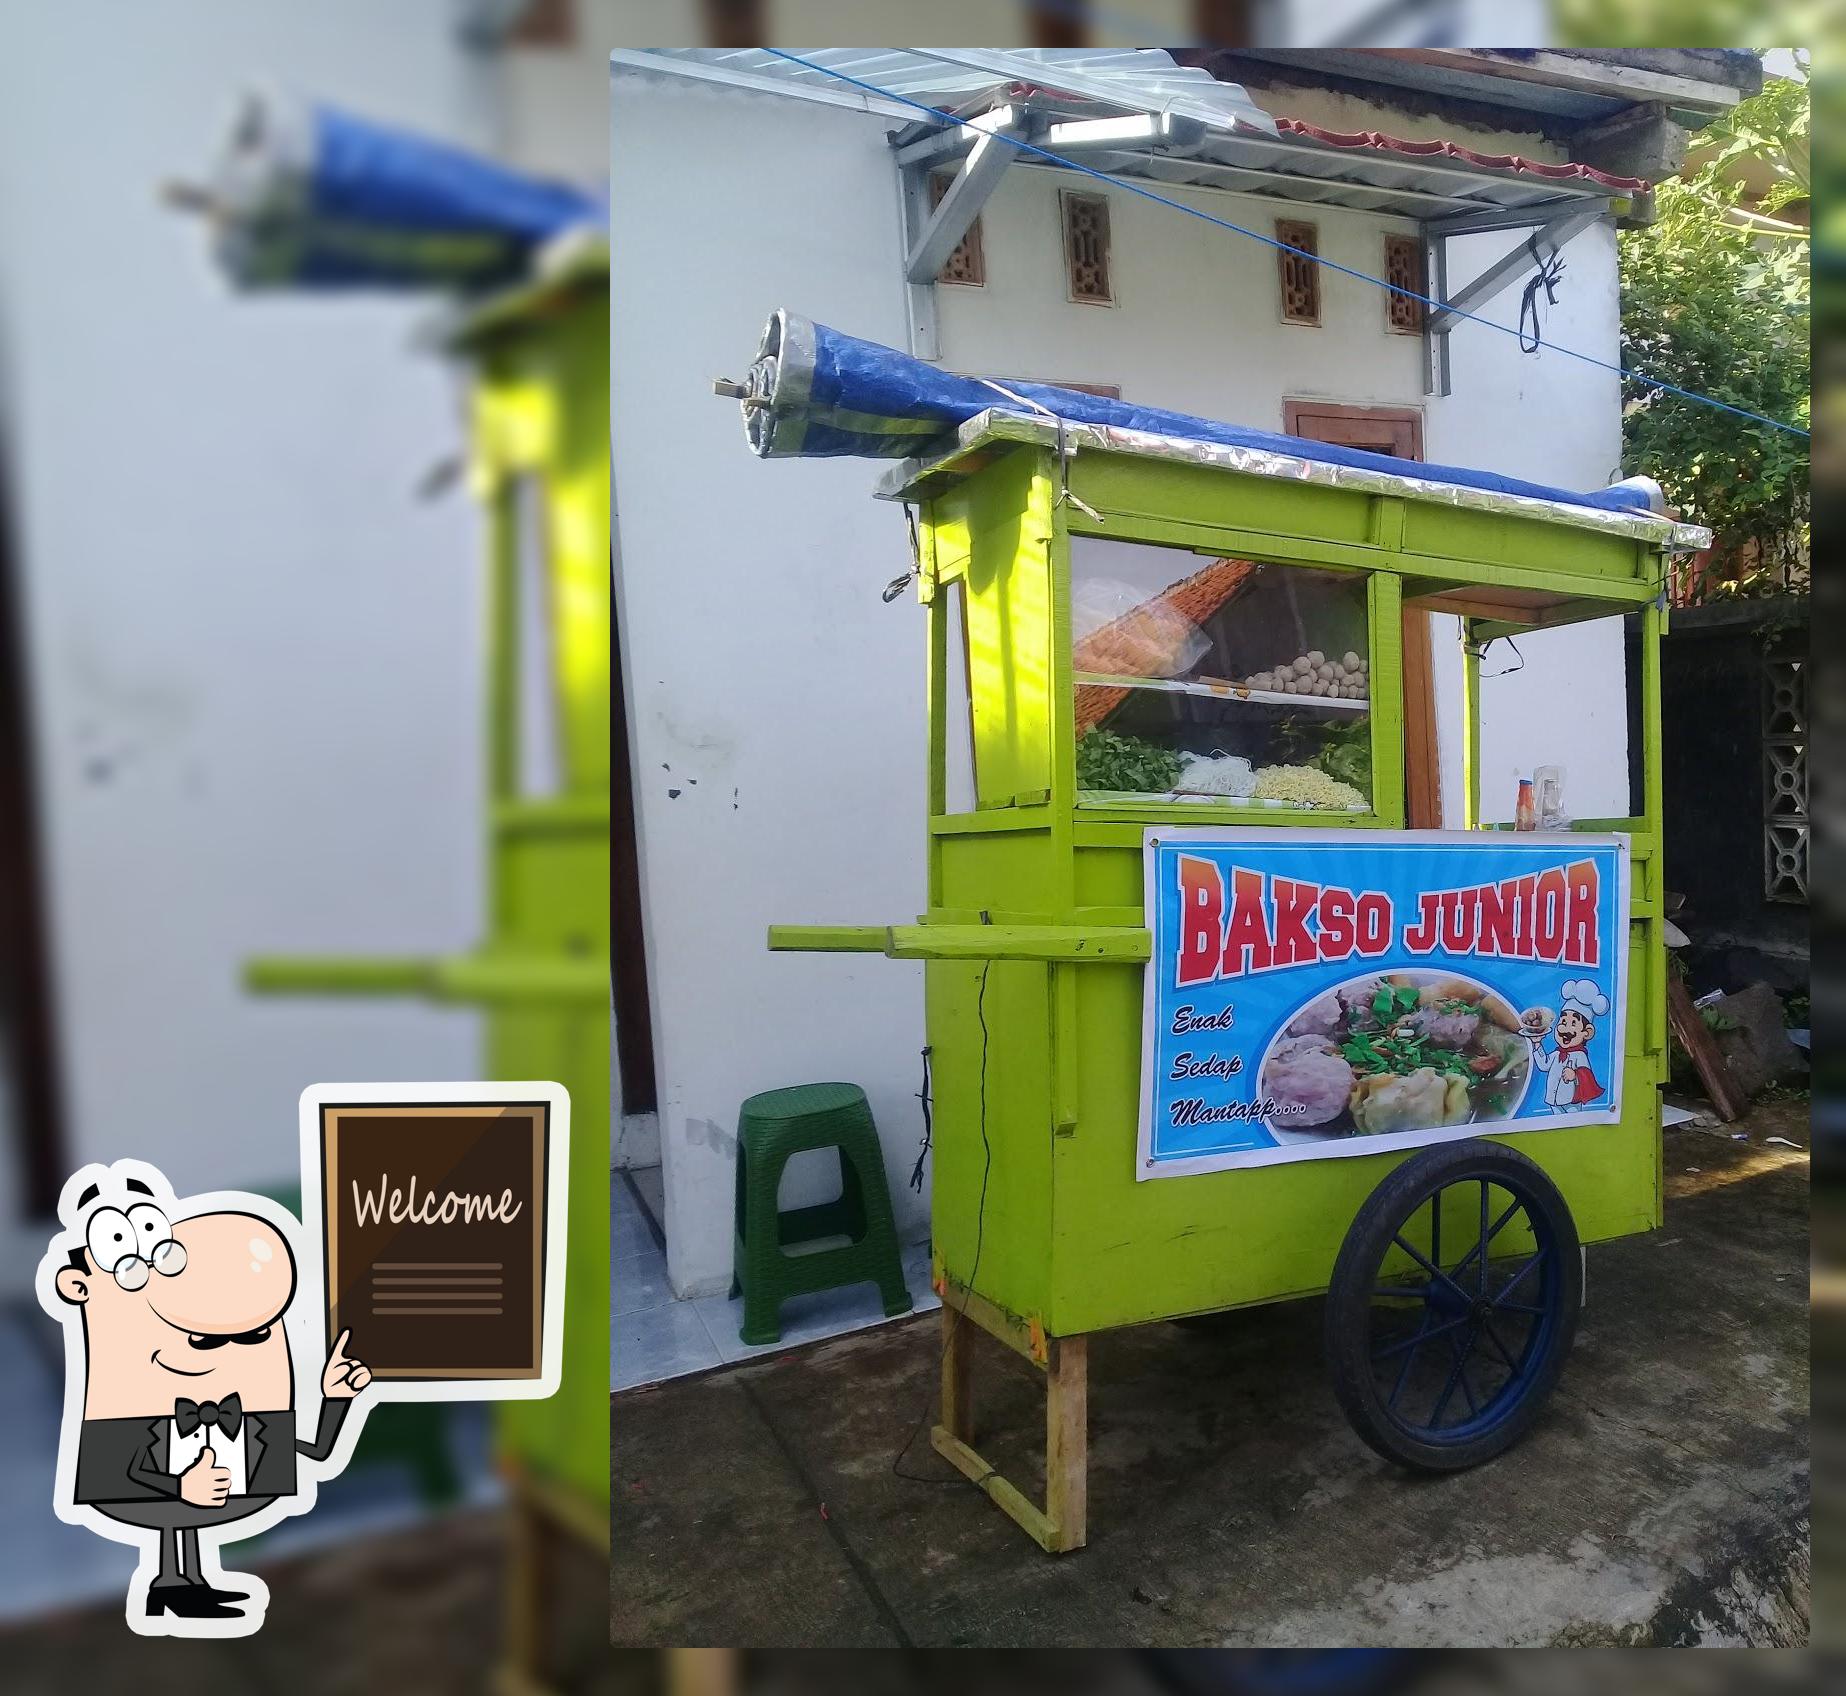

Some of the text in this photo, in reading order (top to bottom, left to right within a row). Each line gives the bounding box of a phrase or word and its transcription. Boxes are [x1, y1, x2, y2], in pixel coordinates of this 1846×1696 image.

[1175, 852, 1601, 988] BAKSO JUNIOR
[1171, 1004, 1233, 1034] Enak
[1169, 1051, 1242, 1081] Sedap
